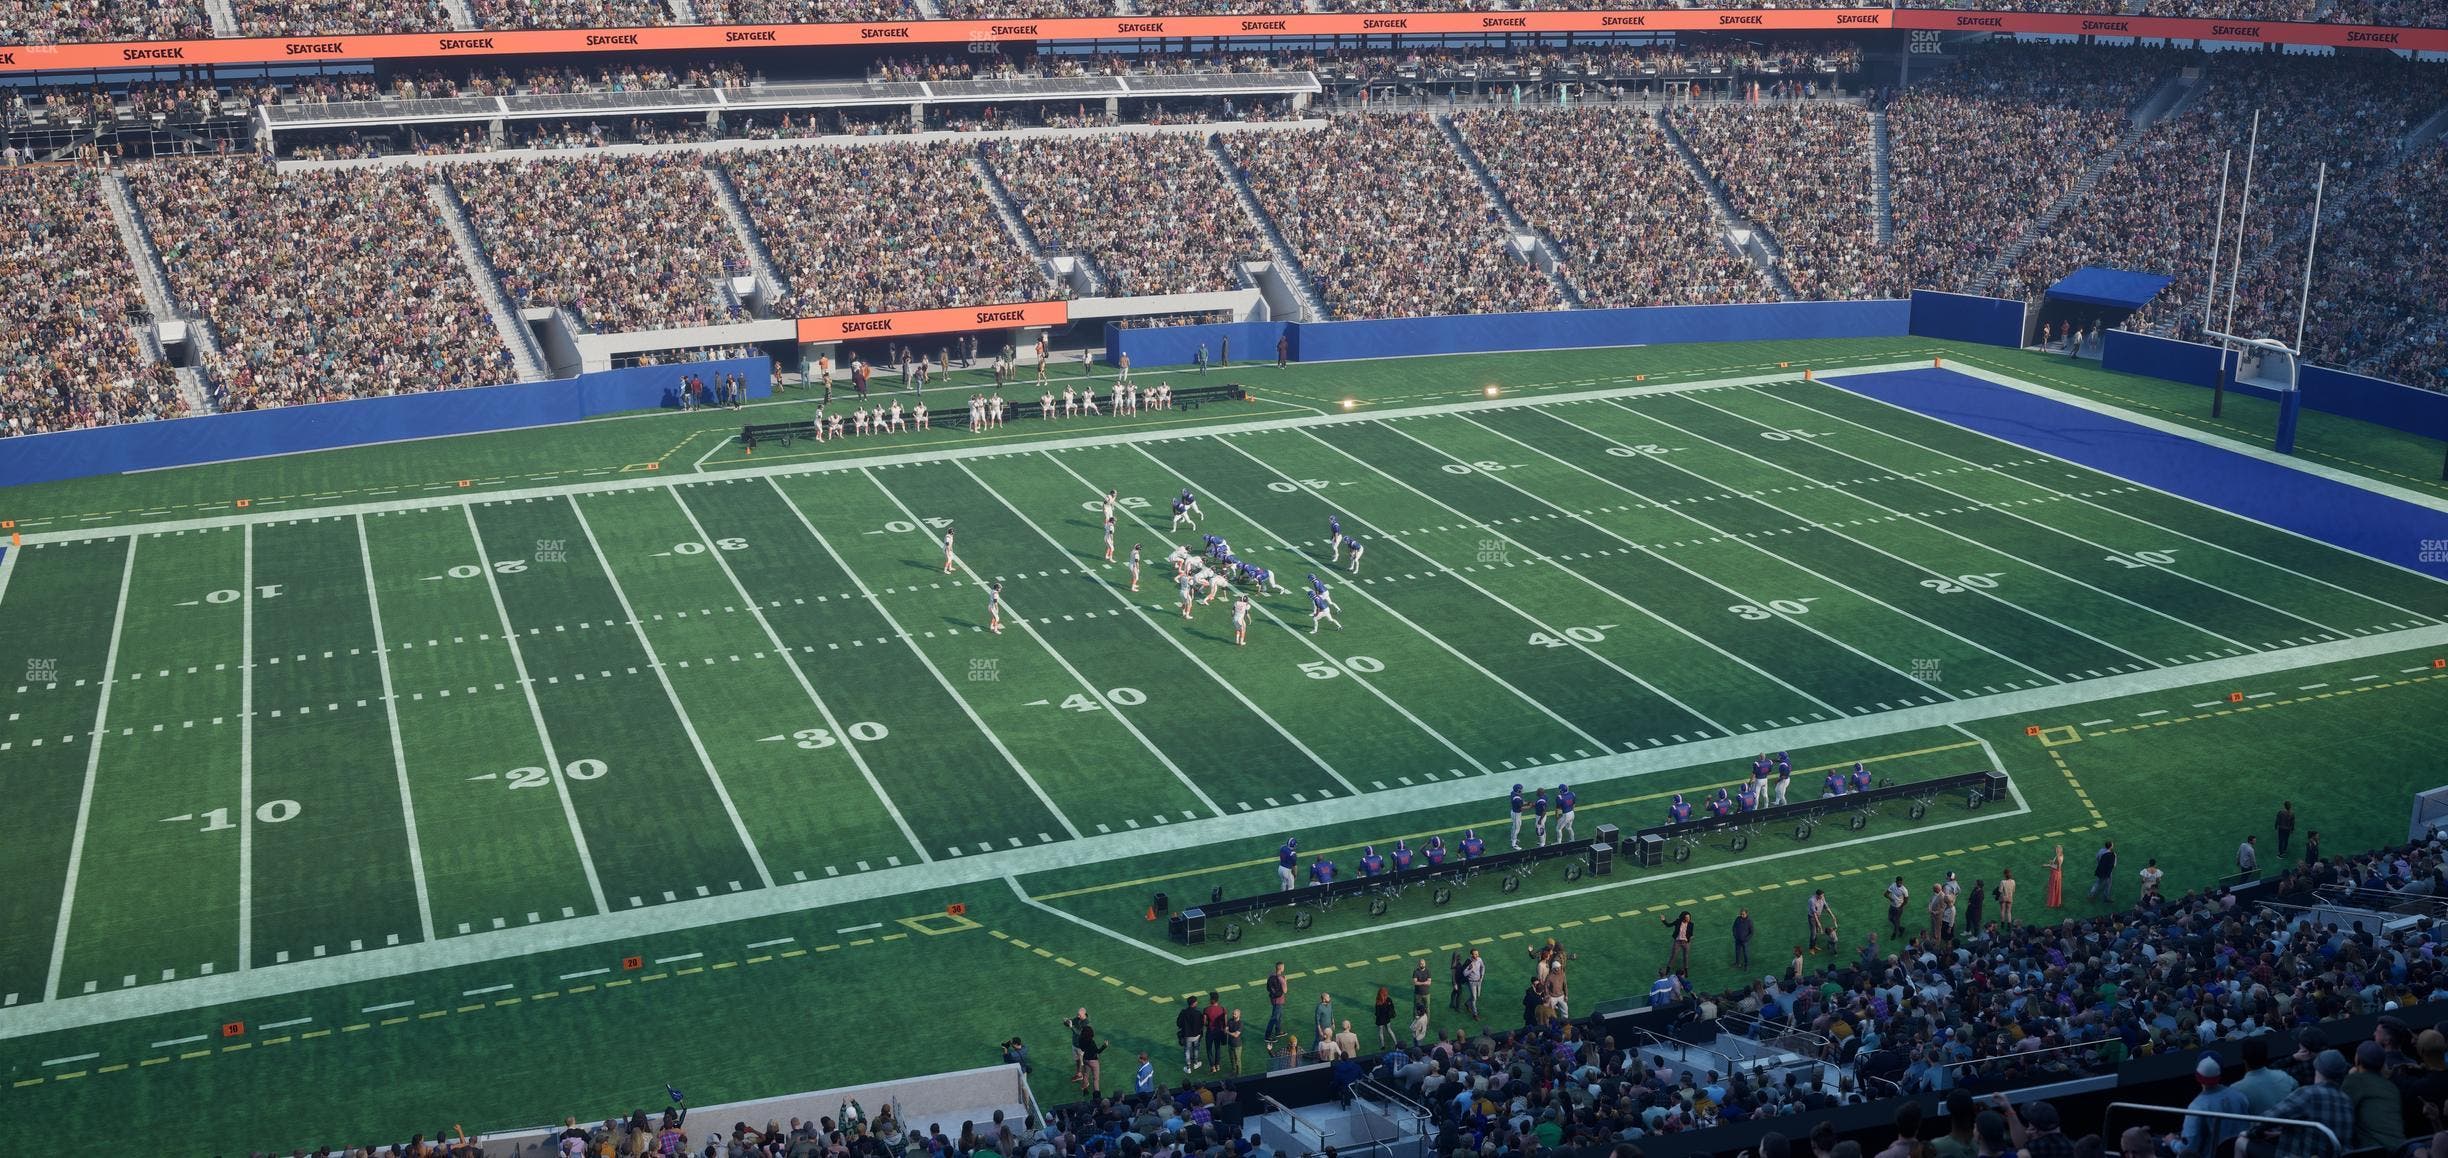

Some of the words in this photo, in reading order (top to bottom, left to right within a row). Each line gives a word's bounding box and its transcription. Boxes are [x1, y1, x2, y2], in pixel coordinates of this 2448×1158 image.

[1241, 20, 1286, 31] SEATGEEK
[1363, 18, 1407, 29] SEATGEEK
[1482, 17, 1526, 28] SEATGEEK
[1602, 16, 1645, 26] SEATGEEK
[1719, 15, 1762, 25] SEATGEEK
[1836, 14, 1879, 24] SEATGEEK
[1957, 16, 2002, 27] SEATGEEK
[992, 25, 1038, 35] SEATGEEK
[1118, 22, 1164, 33] SEATGEEK
[2081, 20, 2128, 32] SEATGEEK
[2212, 25, 2260, 38] SEATGEEK
[586, 34, 638, 46] SEATGEEK
[726, 31, 776, 42] SEATGEEK
[861, 28, 909, 39] SEATGEEK
[2347, 30, 2399, 44] SEATGEEK
[286, 42, 344, 55] SEATGEEK
[440, 37, 494, 50] SEATGEEK
[123, 47, 184, 61] SEATGEEK
[976, 310, 1025, 324] SEATGEEK
[842, 319, 892, 333] SEATGEEK
[2104, 551, 2176, 569] 10
[1920, 574, 1999, 594] 20
[1728, 599, 1809, 620] 30
[1528, 626, 1605, 648] 40
[1296, 655, 1385, 680] 50
[1060, 687, 1147, 712] 40
[793, 721, 889, 750] 30
[505, 758, 608, 790] 20
[200, 799, 301, 832] 10
